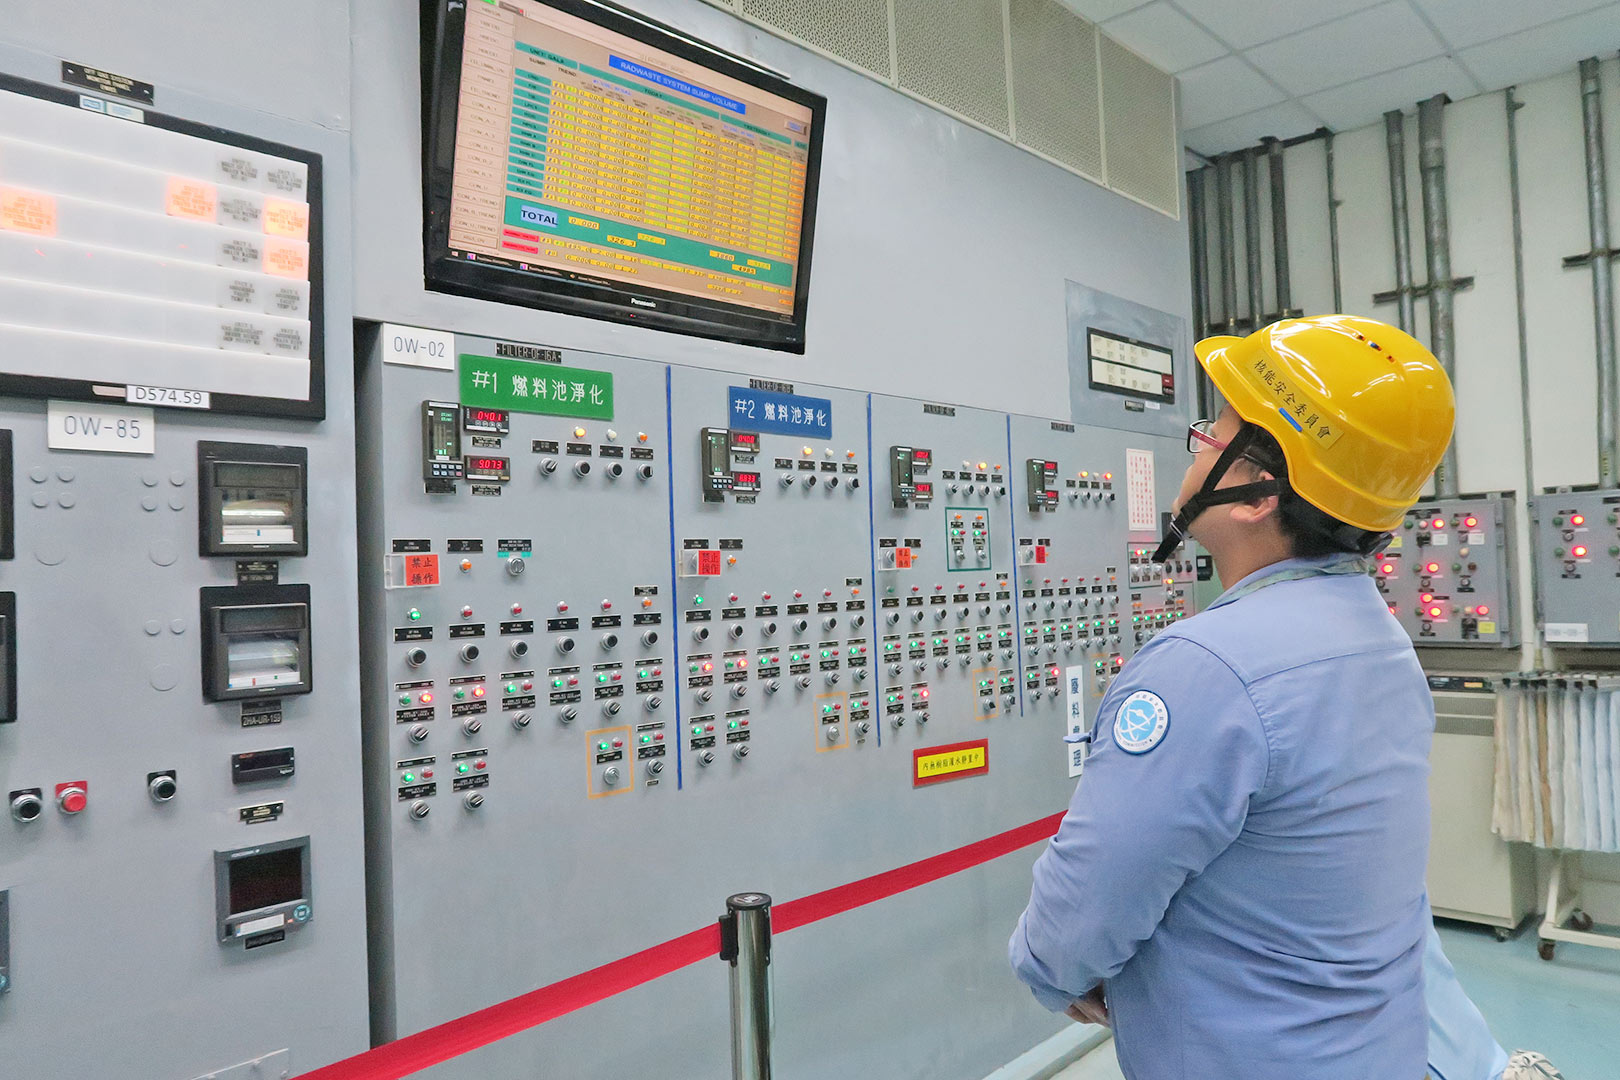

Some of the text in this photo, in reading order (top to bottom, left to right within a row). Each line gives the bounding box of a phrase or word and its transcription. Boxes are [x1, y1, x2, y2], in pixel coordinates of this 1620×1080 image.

[620, 61, 738, 110] RADWASTE SYSTEM SUMP VOLUME
[521, 209, 559, 226] TOTAL
[631, 298, 657, 308] Panasonic
[136, 387, 202, 405] DS74.59
[472, 370, 604, 405] #1 燃料池淨化
[1253, 359, 1331, 439] 核能安全委員會
[735, 399, 827, 427] #2 燃料池淨化
[411, 557, 433, 568] 禁止
[411, 573, 434, 585] 操作
